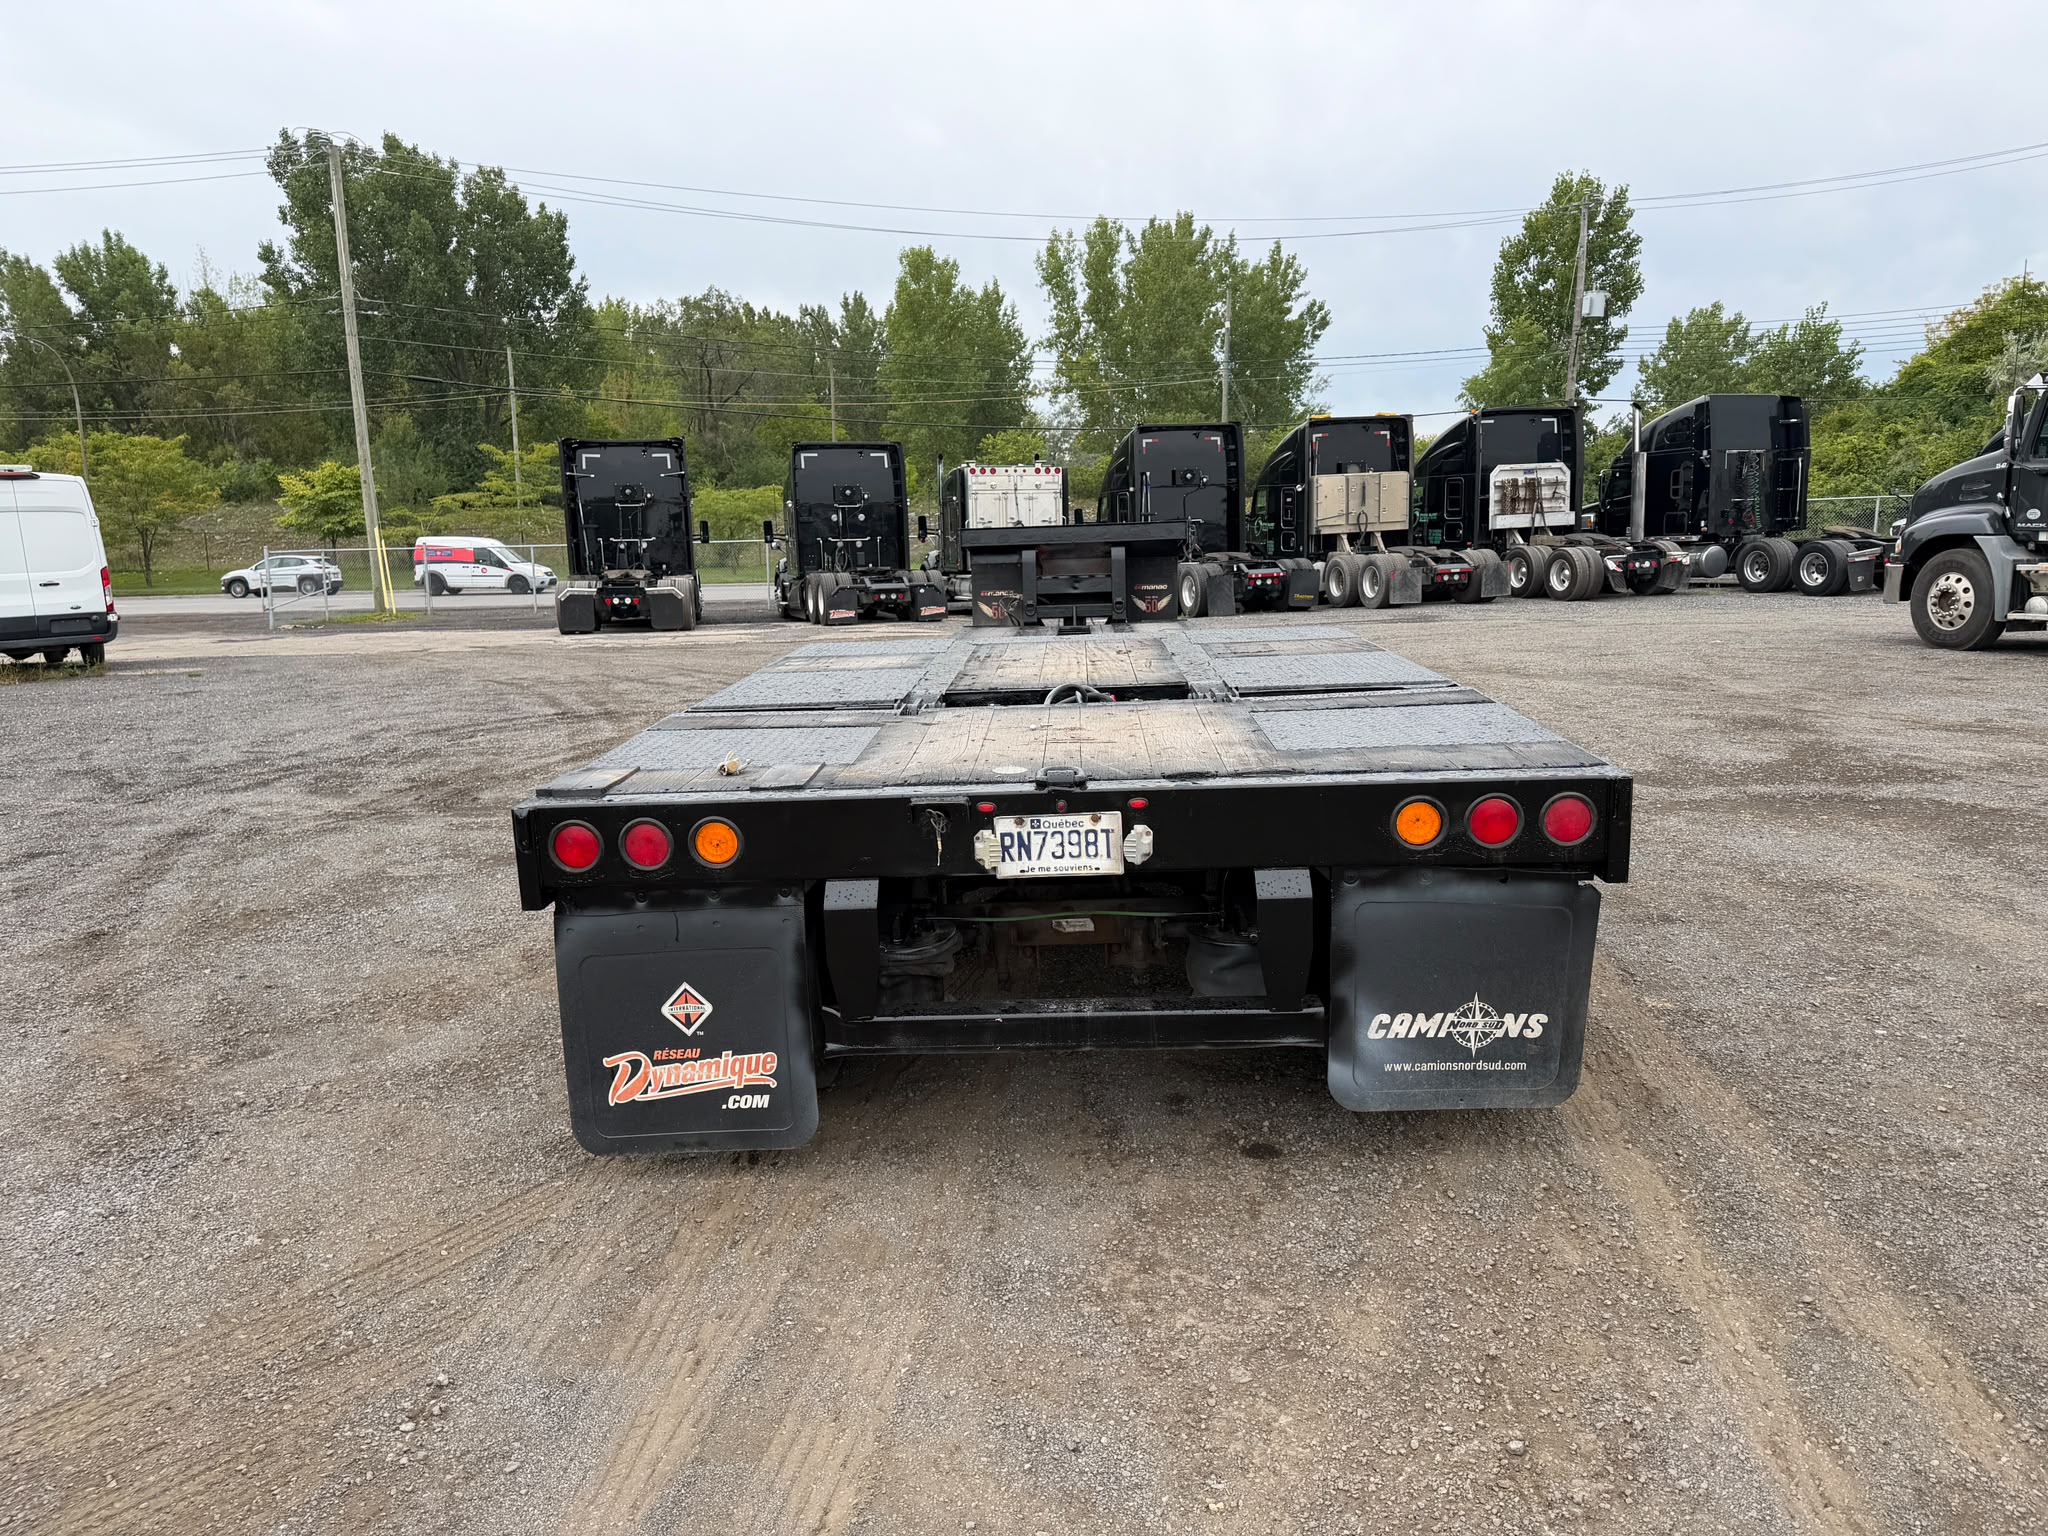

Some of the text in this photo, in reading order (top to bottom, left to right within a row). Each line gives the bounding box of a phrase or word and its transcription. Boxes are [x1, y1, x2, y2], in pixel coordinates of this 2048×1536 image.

[1042, 818, 1085, 828] Québec
[1000, 829, 1115, 862] RN7398T
[1025, 864, 1036, 873] Je
[1054, 864, 1093, 872] souviens
[1447, 1019, 1479, 1030] NORD
[653, 1047, 701, 1061] RÉSEAU
[1383, 1059, 1527, 1072] www.camionsnordsud.com
[603, 1050, 778, 1107] Dynamique
[721, 1094, 770, 1110] .COM
